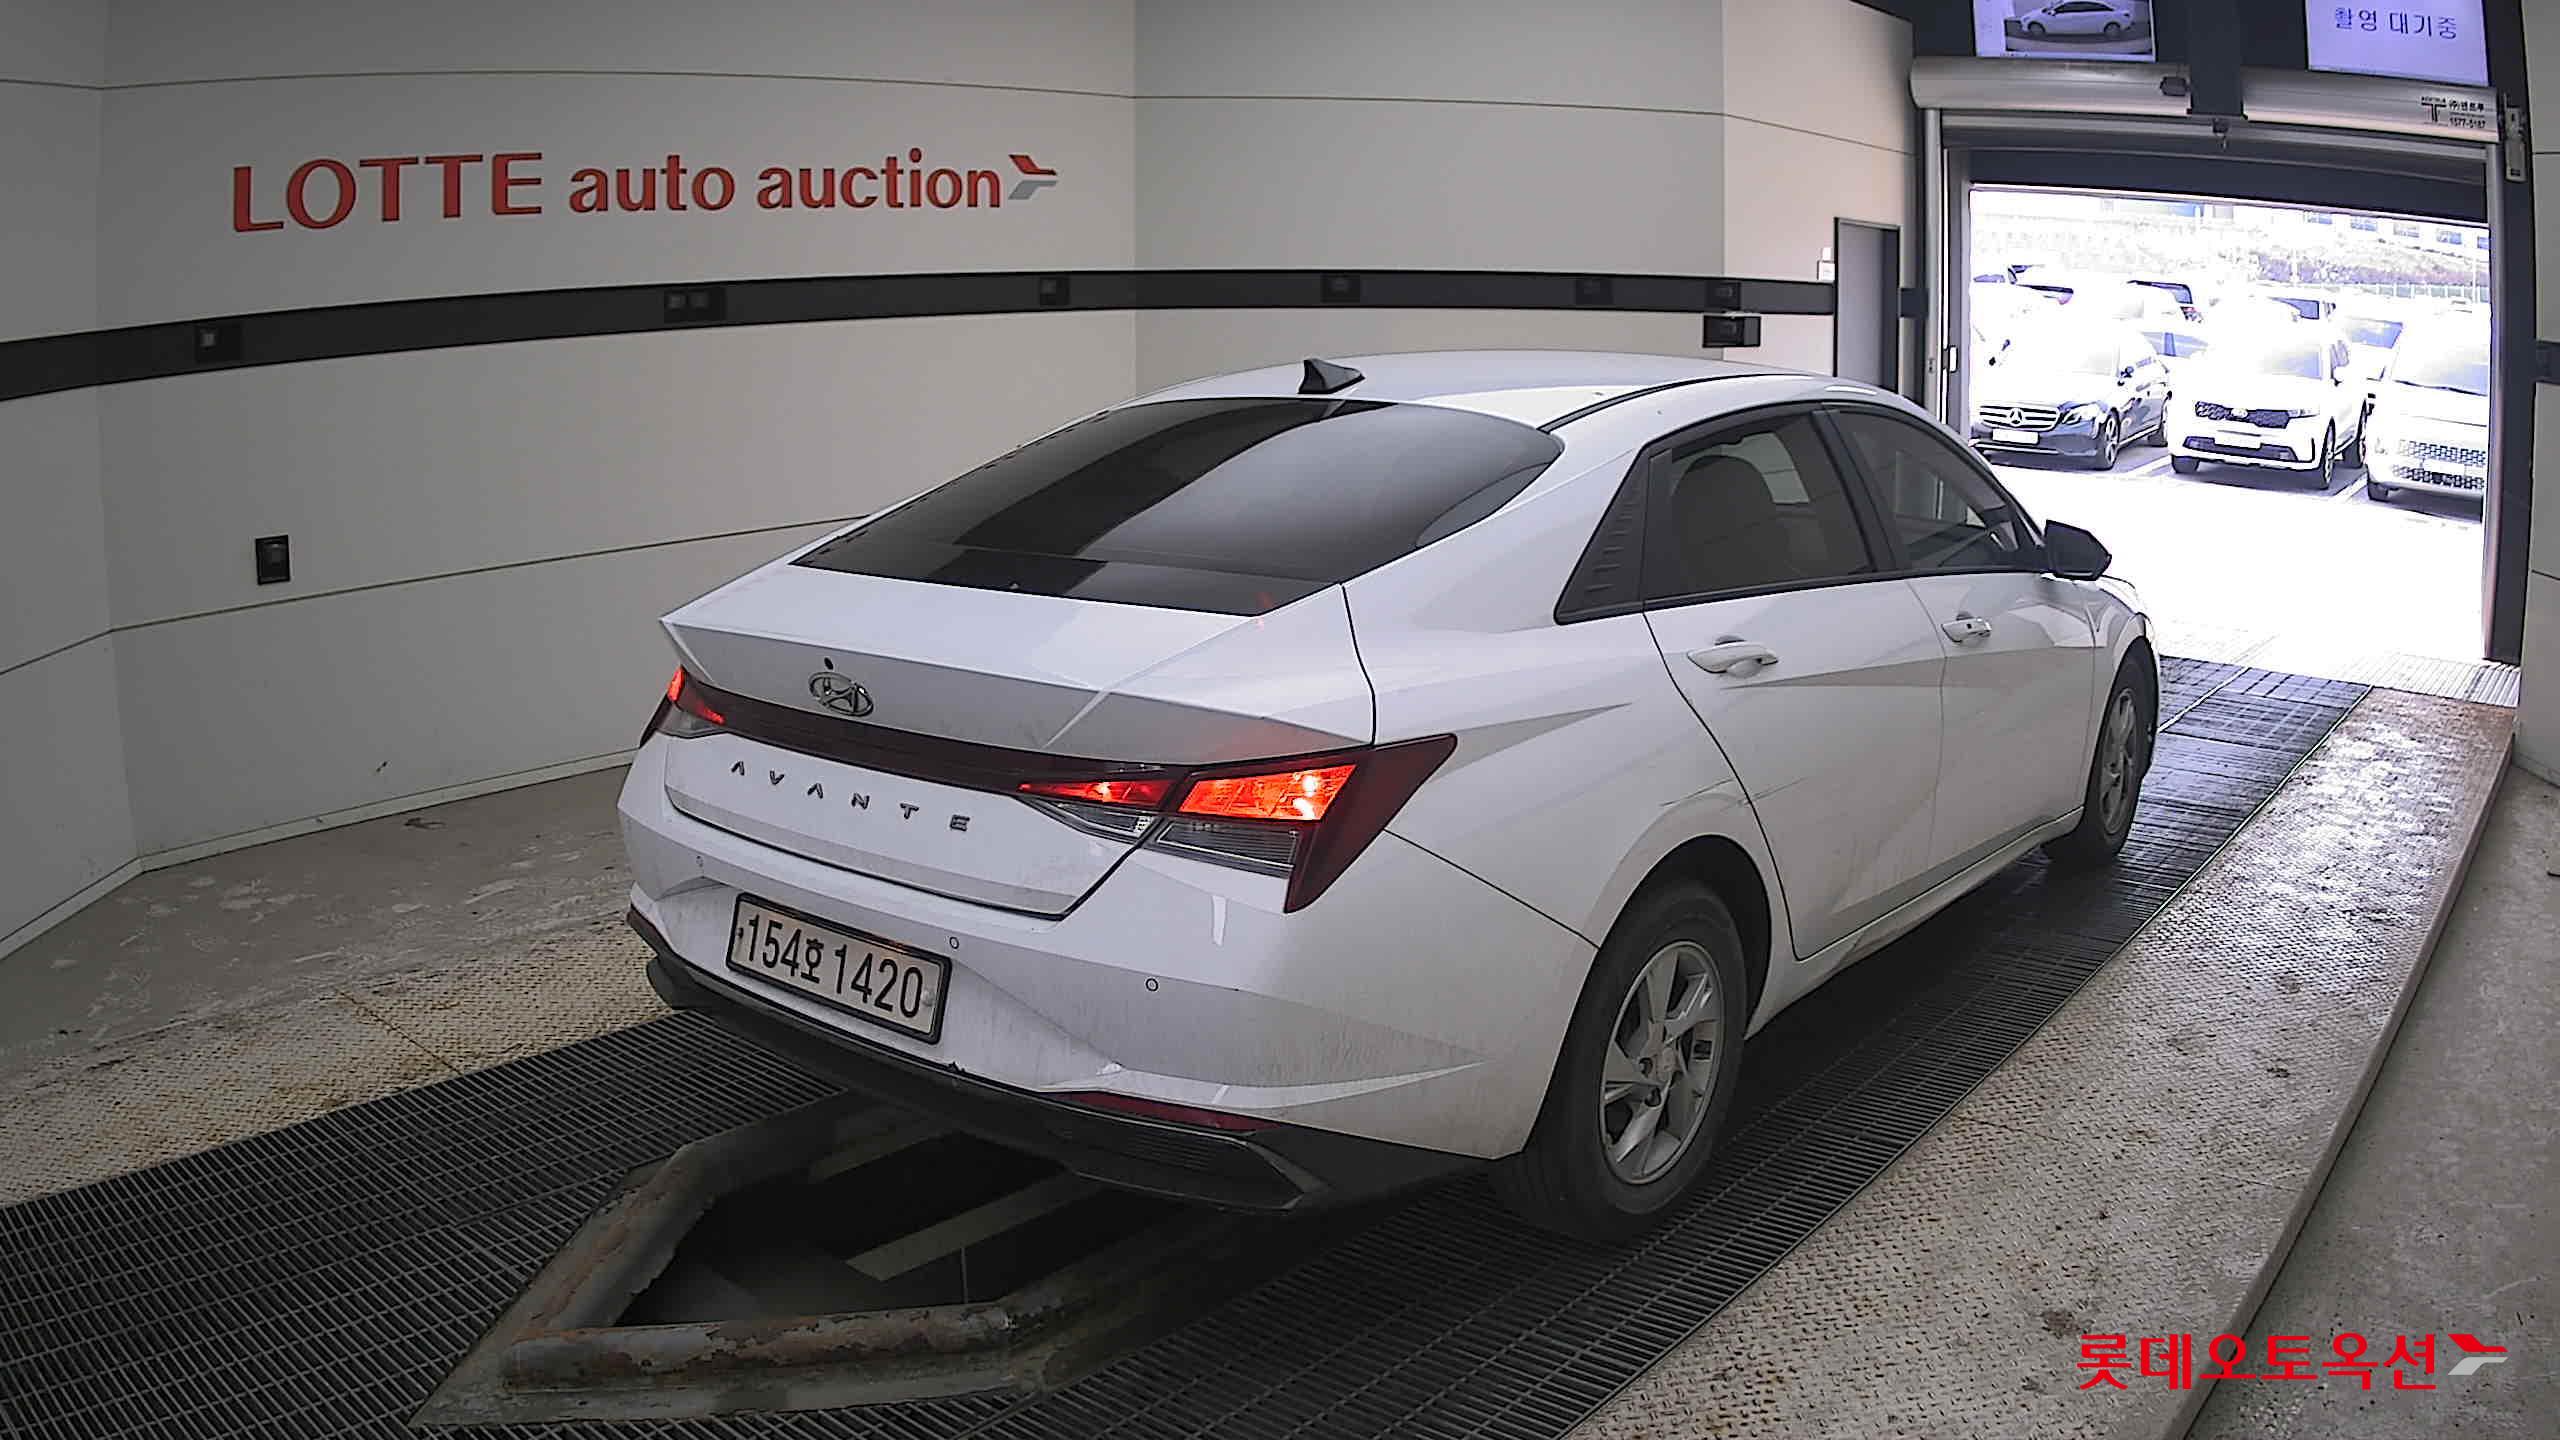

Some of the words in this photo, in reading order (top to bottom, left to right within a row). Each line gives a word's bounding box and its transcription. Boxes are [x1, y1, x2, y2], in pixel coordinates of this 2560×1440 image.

[2389, 11, 2457, 40] 대기중
[233, 151, 543, 233] LOTTE
[568, 154, 735, 214] auto
[757, 147, 1002, 210] auction
[730, 760, 971, 832] AVANTE
[747, 913, 825, 984] 154호
[835, 943, 924, 1018] 1420
